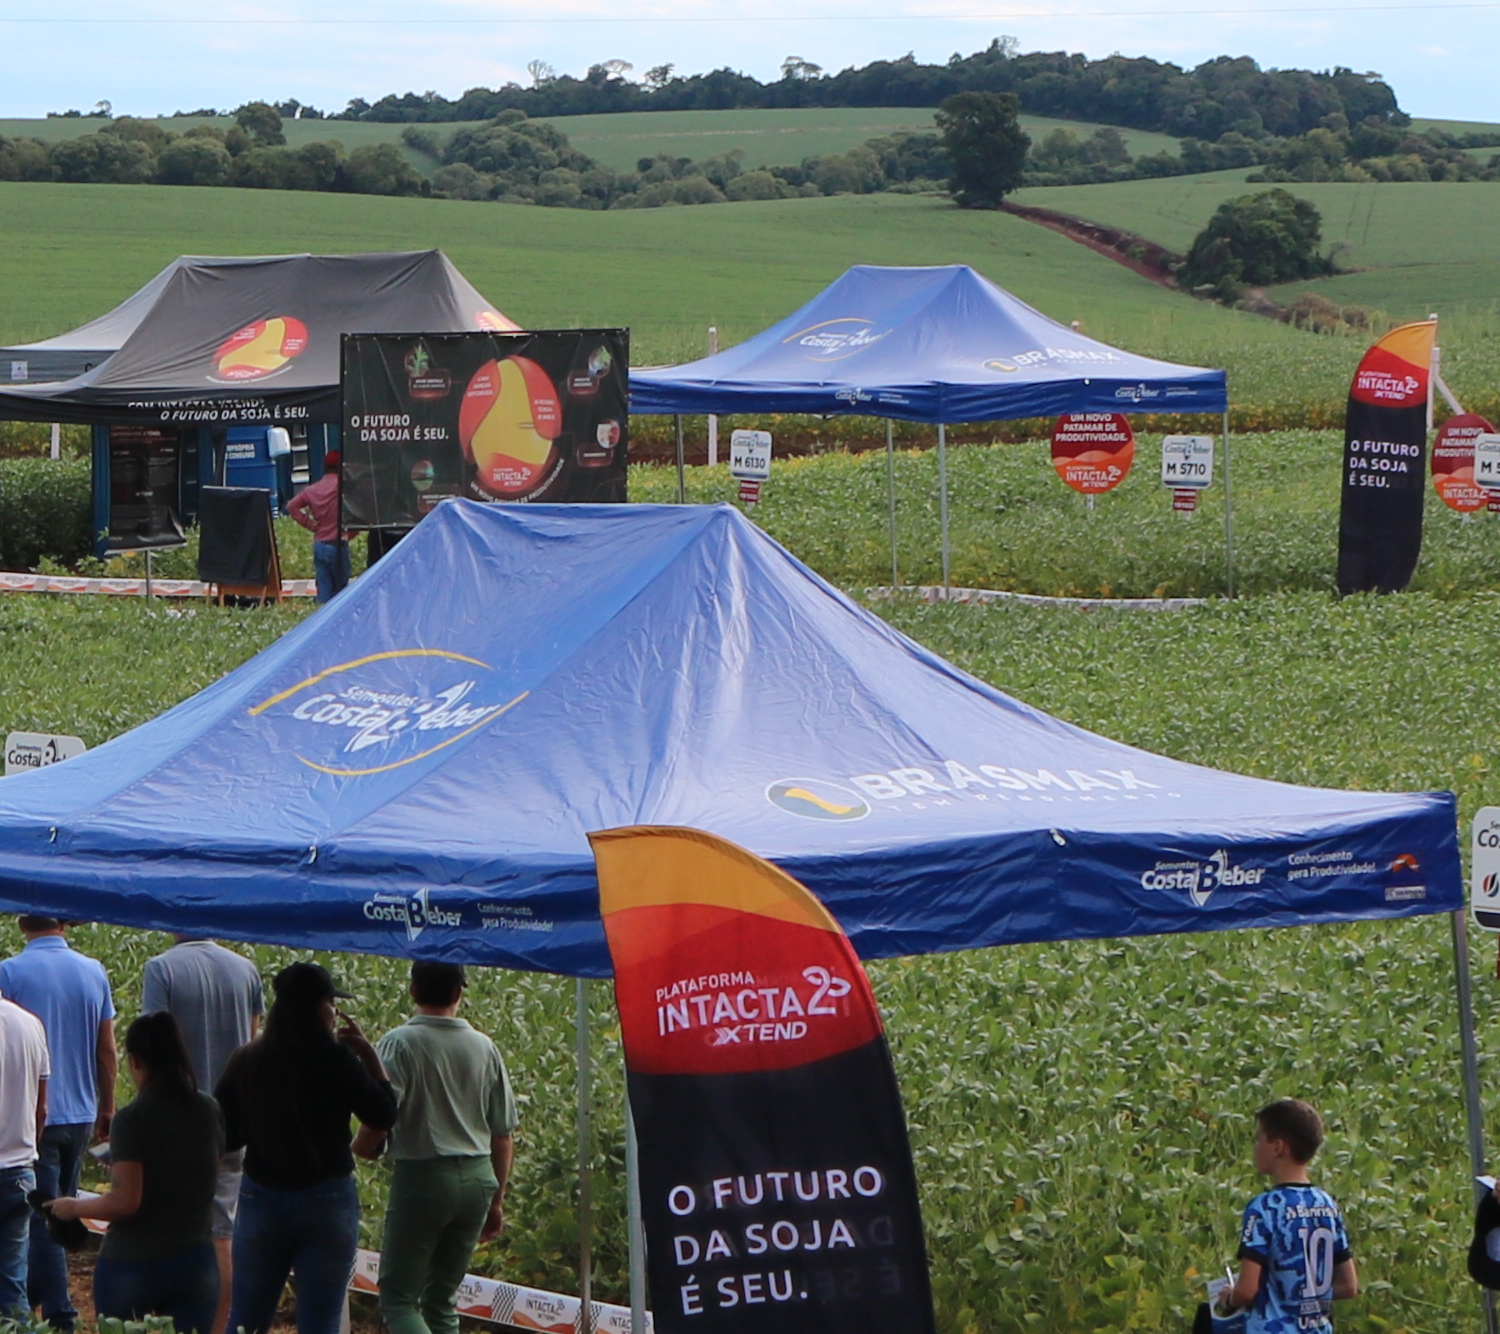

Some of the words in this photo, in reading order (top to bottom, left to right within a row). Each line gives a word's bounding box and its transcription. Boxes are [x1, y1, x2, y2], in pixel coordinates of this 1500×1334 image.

[1012, 347, 1121, 365] BRASMAX
[160, 411, 168, 420] O
[172, 411, 218, 420] FUTURO
[221, 410, 237, 420] DA
[241, 409, 270, 419] SOJA
[274, 405, 281, 418] É
[284, 407, 310, 418] SEU.
[1071, 414, 1084, 422] UM
[1086, 414, 1112, 422] NOVO
[351, 415, 360, 428] O
[363, 414, 410, 427] FUTURO
[1063, 423, 1103, 431] PATAMAR
[361, 429, 377, 441] DA
[380, 428, 410, 441] SOJA
[413, 425, 421, 440] É
[424, 428, 449, 440] SEU.
[1056, 433, 1128, 441] PRODUTIVIDADE.
[1448, 428, 1459, 436] UM
[1351, 440, 1359, 452] O
[1363, 441, 1419, 457] FUTURO
[735, 456, 742, 466] M
[745, 457, 765, 468] 6130
[1167, 464, 1176, 474] M
[1180, 464, 1206, 475] 5710
[1350, 457, 1367, 469] DA
[1371, 458, 1408, 473] SOJA
[1481, 461, 1492, 473] M
[1349, 472, 1356, 487] É
[1360, 475, 1390, 488] SEU.
[344, 685, 417, 707] Sementes
[849, 759, 1163, 800] BRASMAX
[888, 797, 952, 813] TEM
[975, 792, 1181, 804] RENDIMENTO
[1155, 860, 1199, 871] Sementes
[1288, 850, 1353, 866] Conhecimento
[1140, 858, 1266, 897] CostaBeber
[1288, 867, 1308, 881] gera
[1310, 862, 1376, 878] Produtividade!
[363, 893, 462, 934] CostaBeber
[477, 903, 533, 916] Conhecimento
[655, 970, 755, 1003] PLATAFORMA
[668, 1184, 696, 1217] O
[713, 1165, 883, 1210] FUTURO
[673, 1229, 733, 1267] DA
[745, 1218, 856, 1255] SOJA
[1298, 1227, 1334, 1298] 10
[680, 1274, 703, 1316] É
[716, 1269, 809, 1309] SEU.
